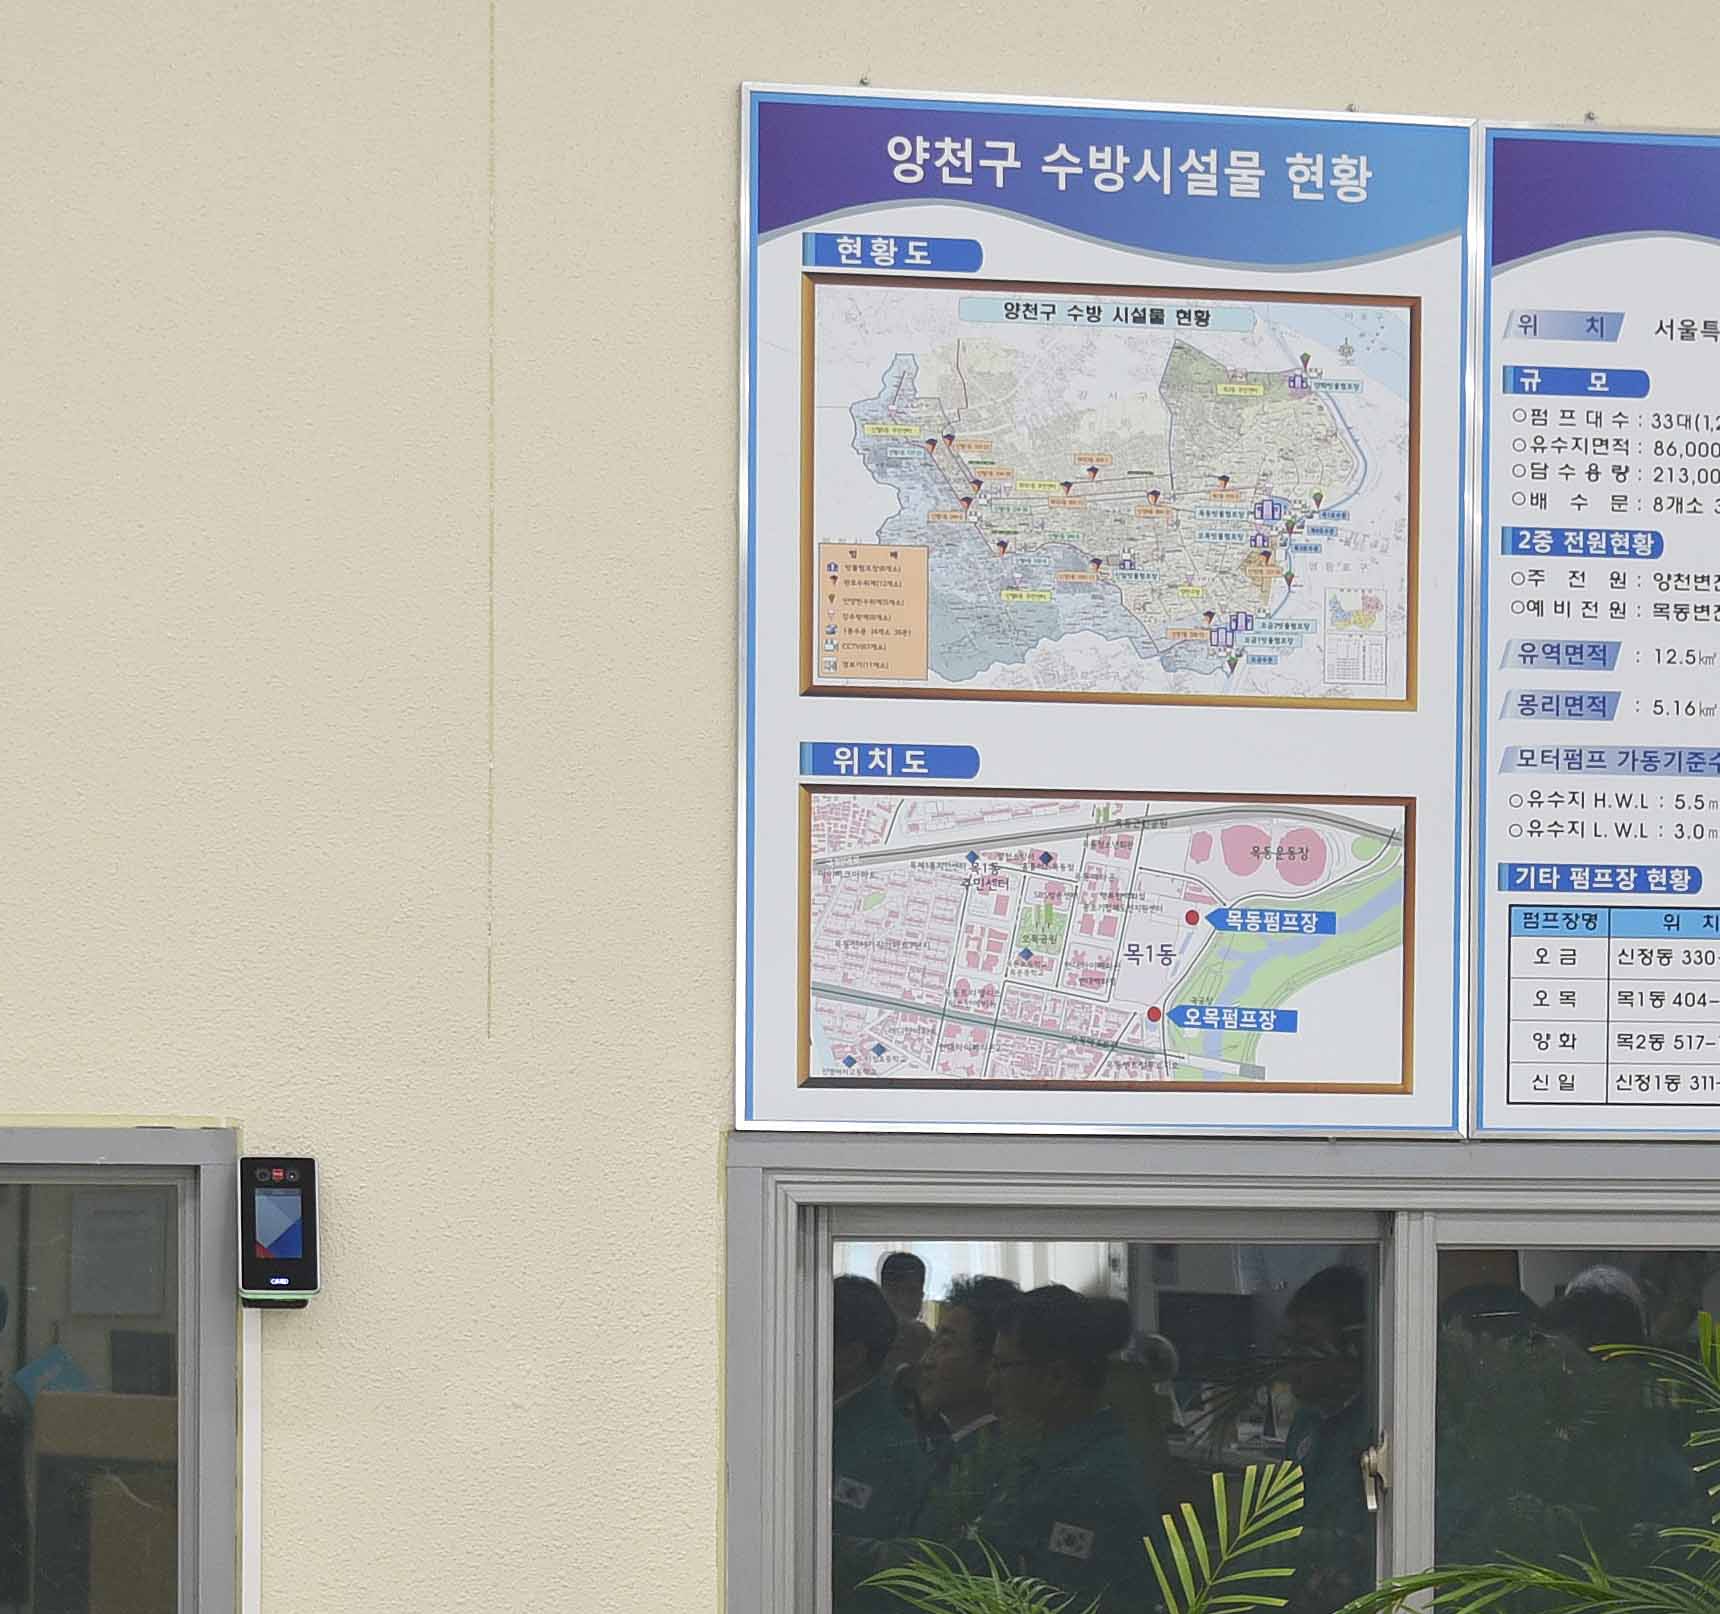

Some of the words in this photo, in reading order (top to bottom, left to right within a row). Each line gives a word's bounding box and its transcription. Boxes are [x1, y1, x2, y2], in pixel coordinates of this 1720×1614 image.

[886, 134, 1021, 187] 양천구
[1040, 145, 1266, 200] 수방시설물
[1285, 152, 1373, 202] 현황
[835, 236, 932, 265] 현황도
[1004, 301, 1056, 321] 양천구
[1067, 303, 1102, 323] 수방
[1113, 304, 1165, 325] 시설물
[1176, 307, 1210, 328] 현황
[1653, 497, 1704, 514] 8개소
[1518, 530, 1553, 552] 2중
[1564, 531, 1655, 556] 전원현황
[1518, 642, 1606, 667] 유역면적
[1518, 694, 1606, 717] 몽리면적
[833, 746, 929, 776] 위치도
[1517, 749, 1607, 771] 모터펌프
[1594, 793, 1649, 809] H.W.L
[1516, 867, 1559, 889] 기타
[1570, 868, 1637, 890] 펌프장
[1646, 869, 1692, 890] 현황
[1226, 910, 1318, 932] 목동펌프장
[1523, 913, 1598, 931] 펌프장명
[1123, 943, 1176, 966] 목1동
[1618, 948, 1673, 967] 신정동
[1618, 991, 1666, 1008] 목1동
[1184, 1007, 1276, 1029] 오목펌프장
[1617, 1034, 1665, 1051] 목2동
[1616, 1074, 1680, 1092] 신정1동
